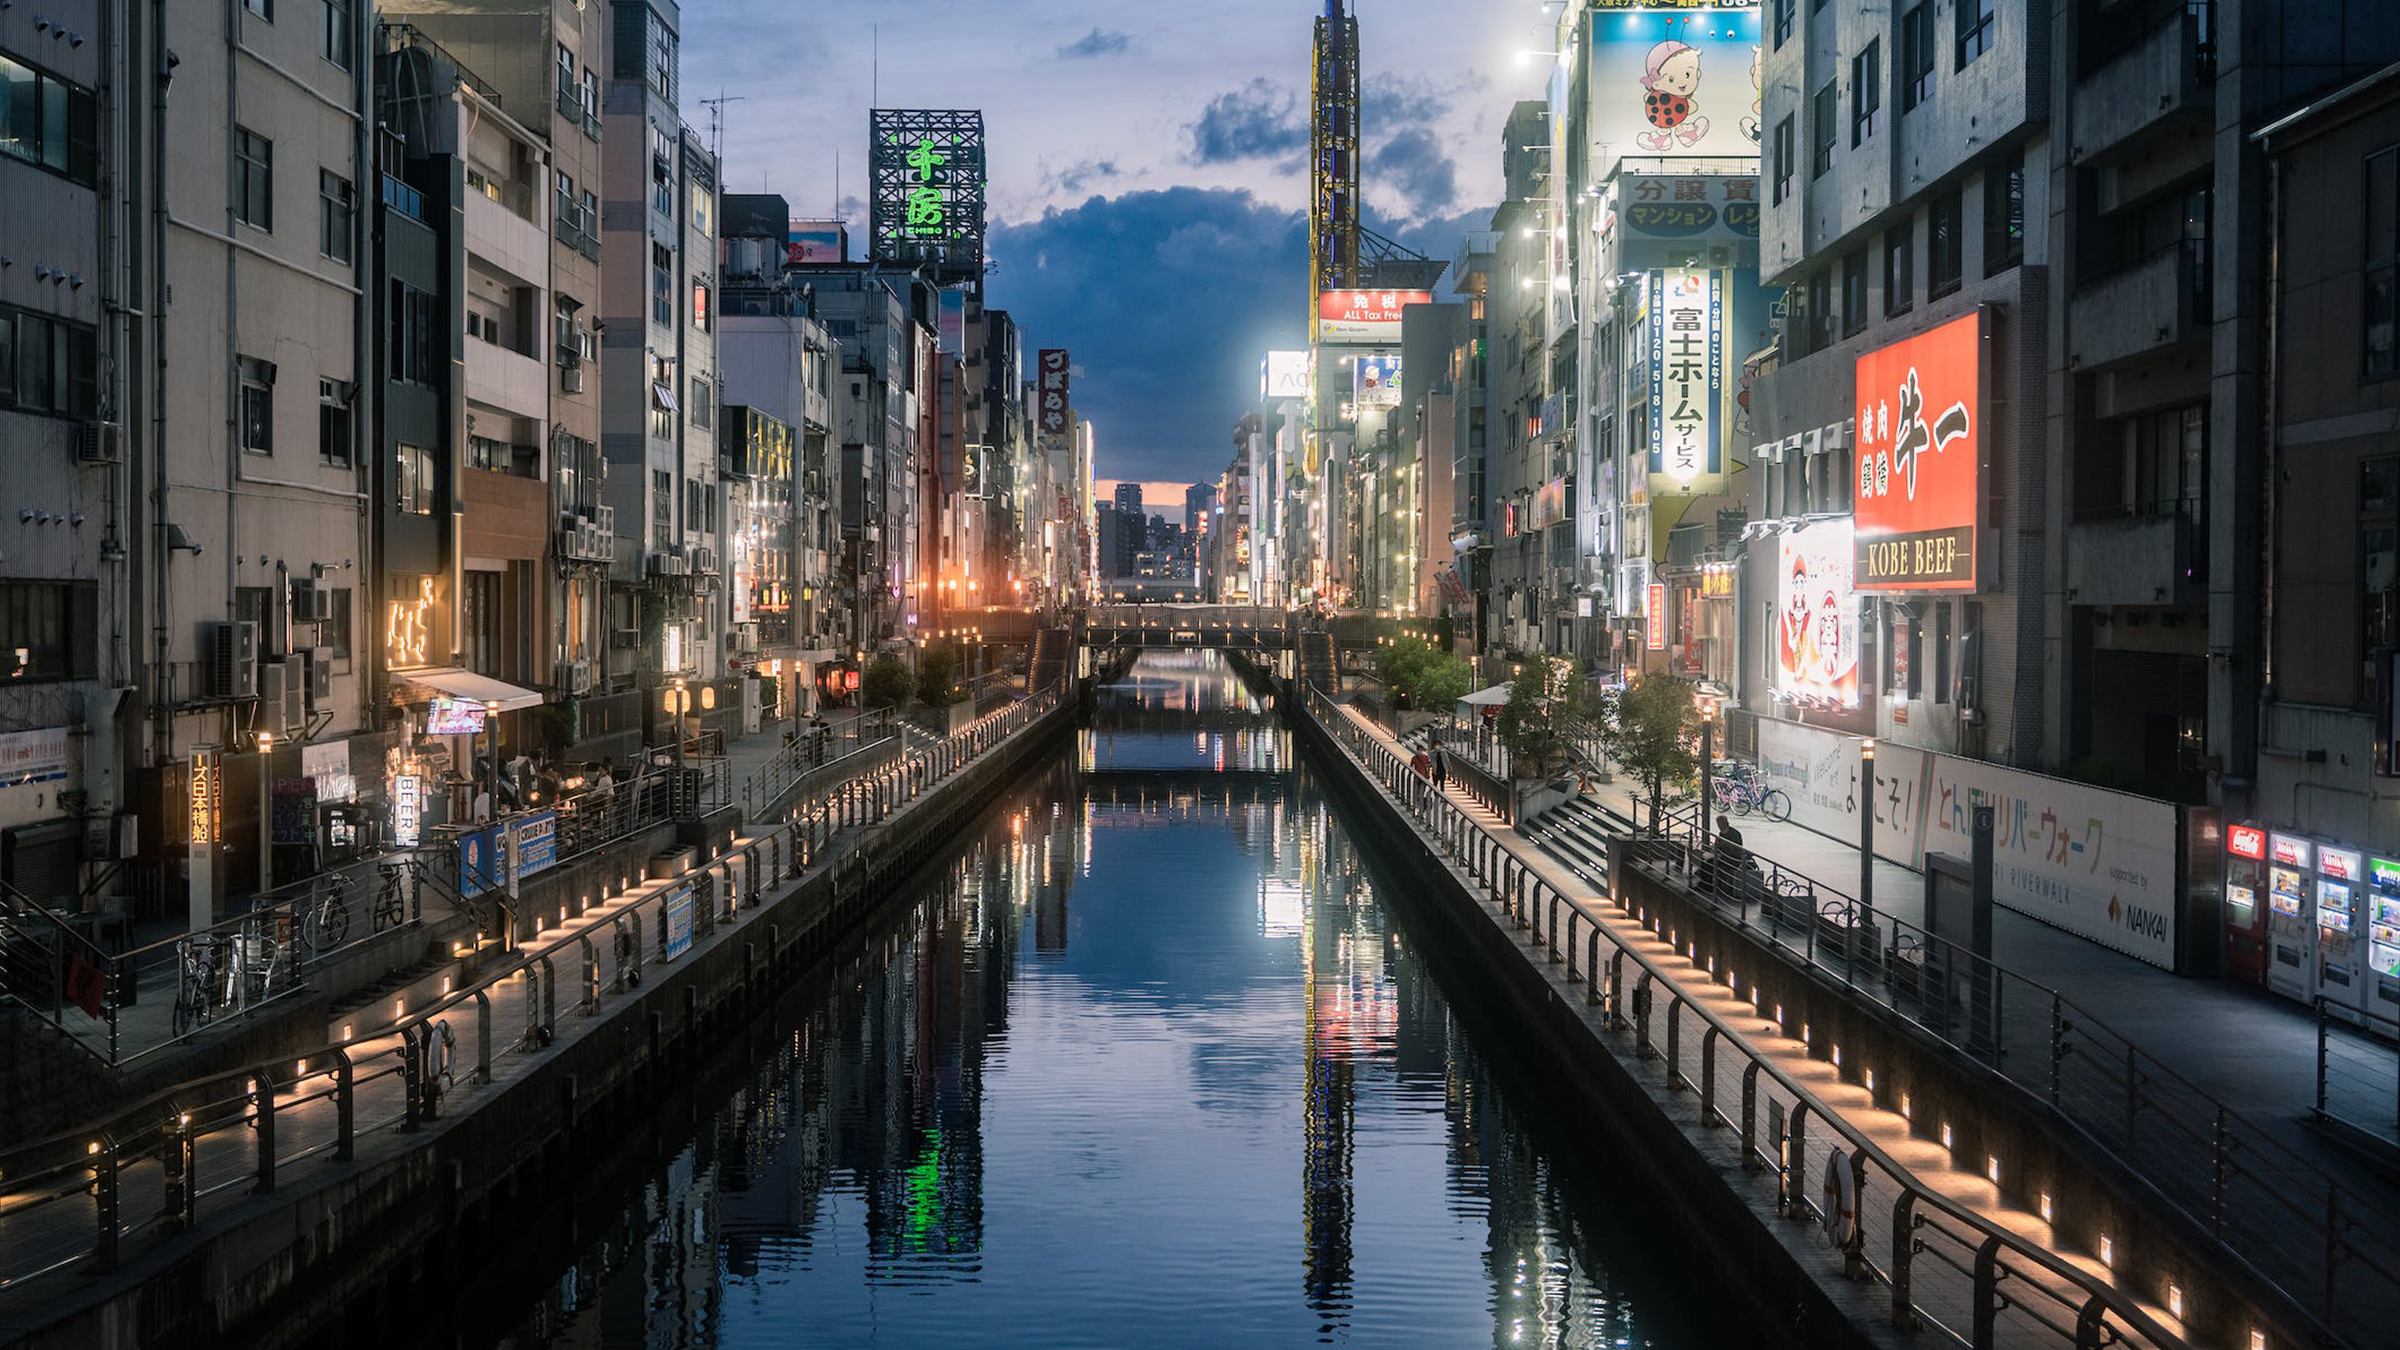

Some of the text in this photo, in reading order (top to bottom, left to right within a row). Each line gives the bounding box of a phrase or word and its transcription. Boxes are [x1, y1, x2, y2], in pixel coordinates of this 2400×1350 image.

[907, 139, 944, 225] 千房
[1635, 180, 1706, 201] 分譲
[907, 227, 943, 235] CHIBO
[1632, 207, 1713, 225] マンション
[1344, 311, 1361, 320] ALL
[1364, 311, 1381, 320] Tax
[1354, 294, 1397, 309] 免税
[1045, 352, 1063, 430] つぼらや
[1668, 308, 1703, 469] 富士ホームサービス
[1894, 366, 1969, 501] 牛一
[1868, 541, 1909, 576] KOBE
[1914, 536, 1956, 575] BEEF
[401, 779, 413, 829] BEER
[1846, 764, 1913, 835] よこそ！
[2011, 868, 2071, 906] RIVERWALK
[2108, 866, 2149, 891] supported by
[2126, 904, 2168, 942] NANKAI
